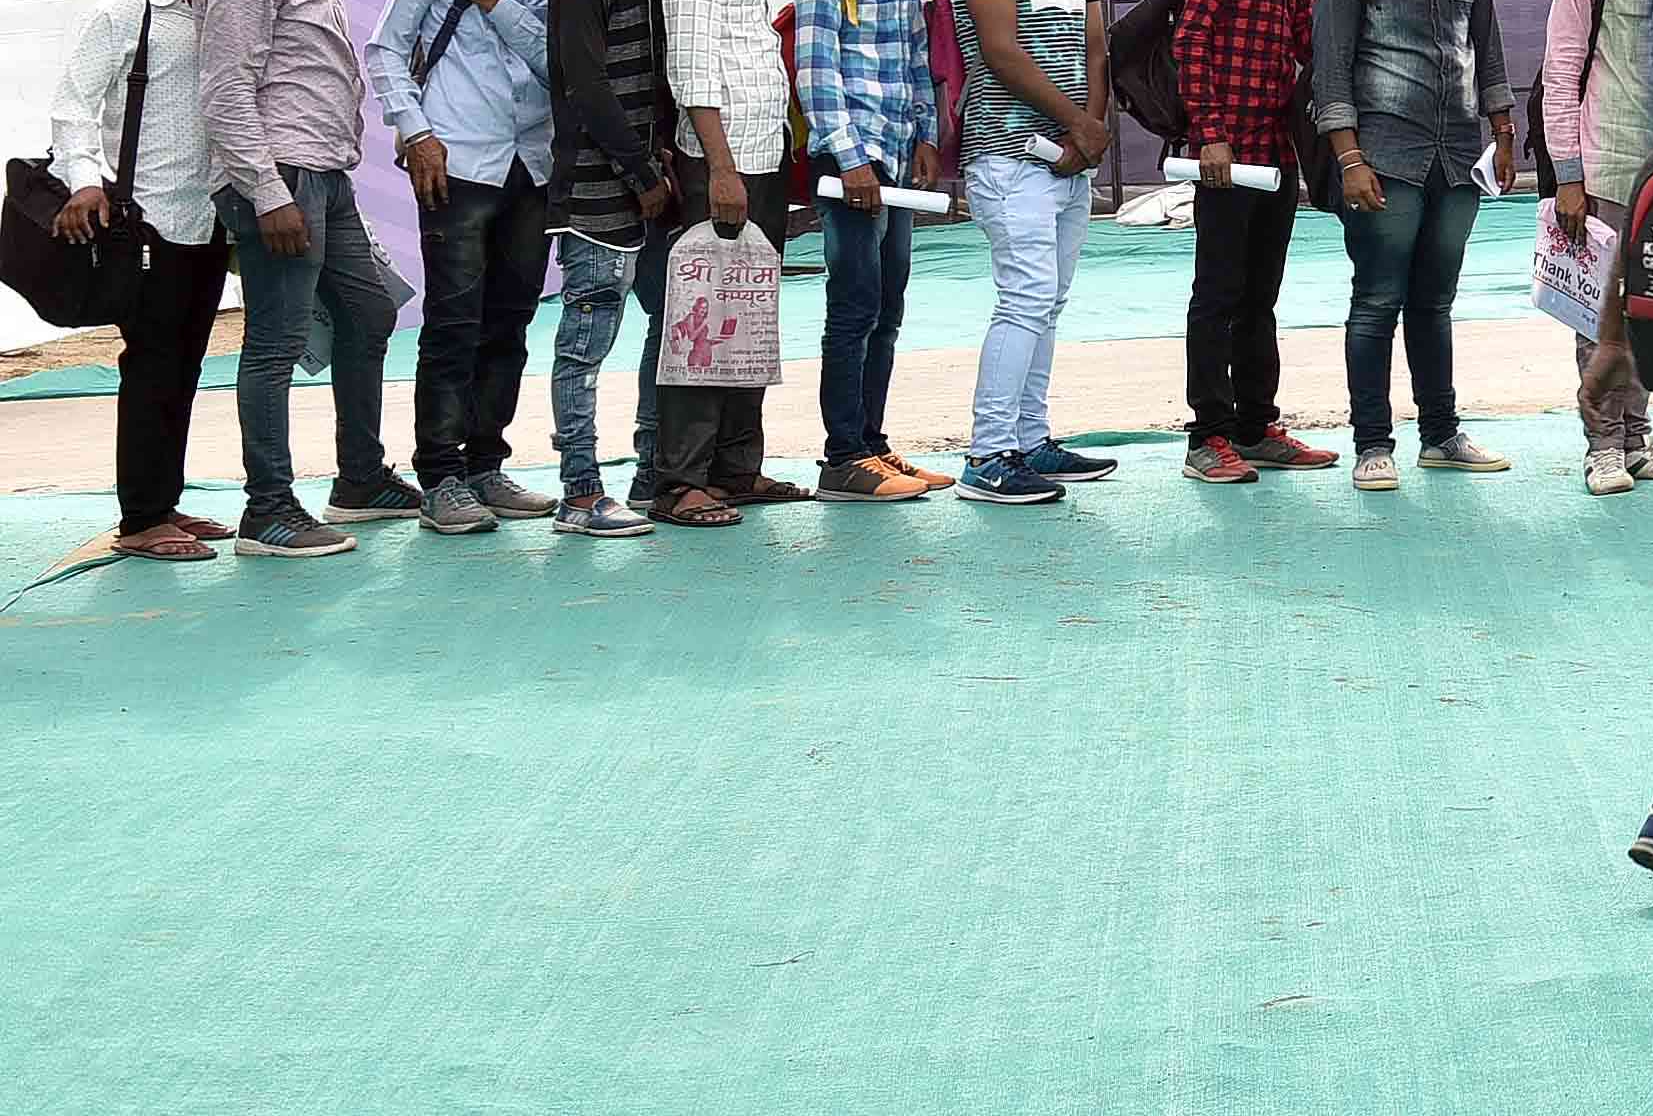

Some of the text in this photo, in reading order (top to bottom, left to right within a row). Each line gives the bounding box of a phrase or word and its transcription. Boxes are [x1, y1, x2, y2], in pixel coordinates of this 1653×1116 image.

[677, 257, 716, 282] श्री
[1534, 251, 1600, 300] Thank You
